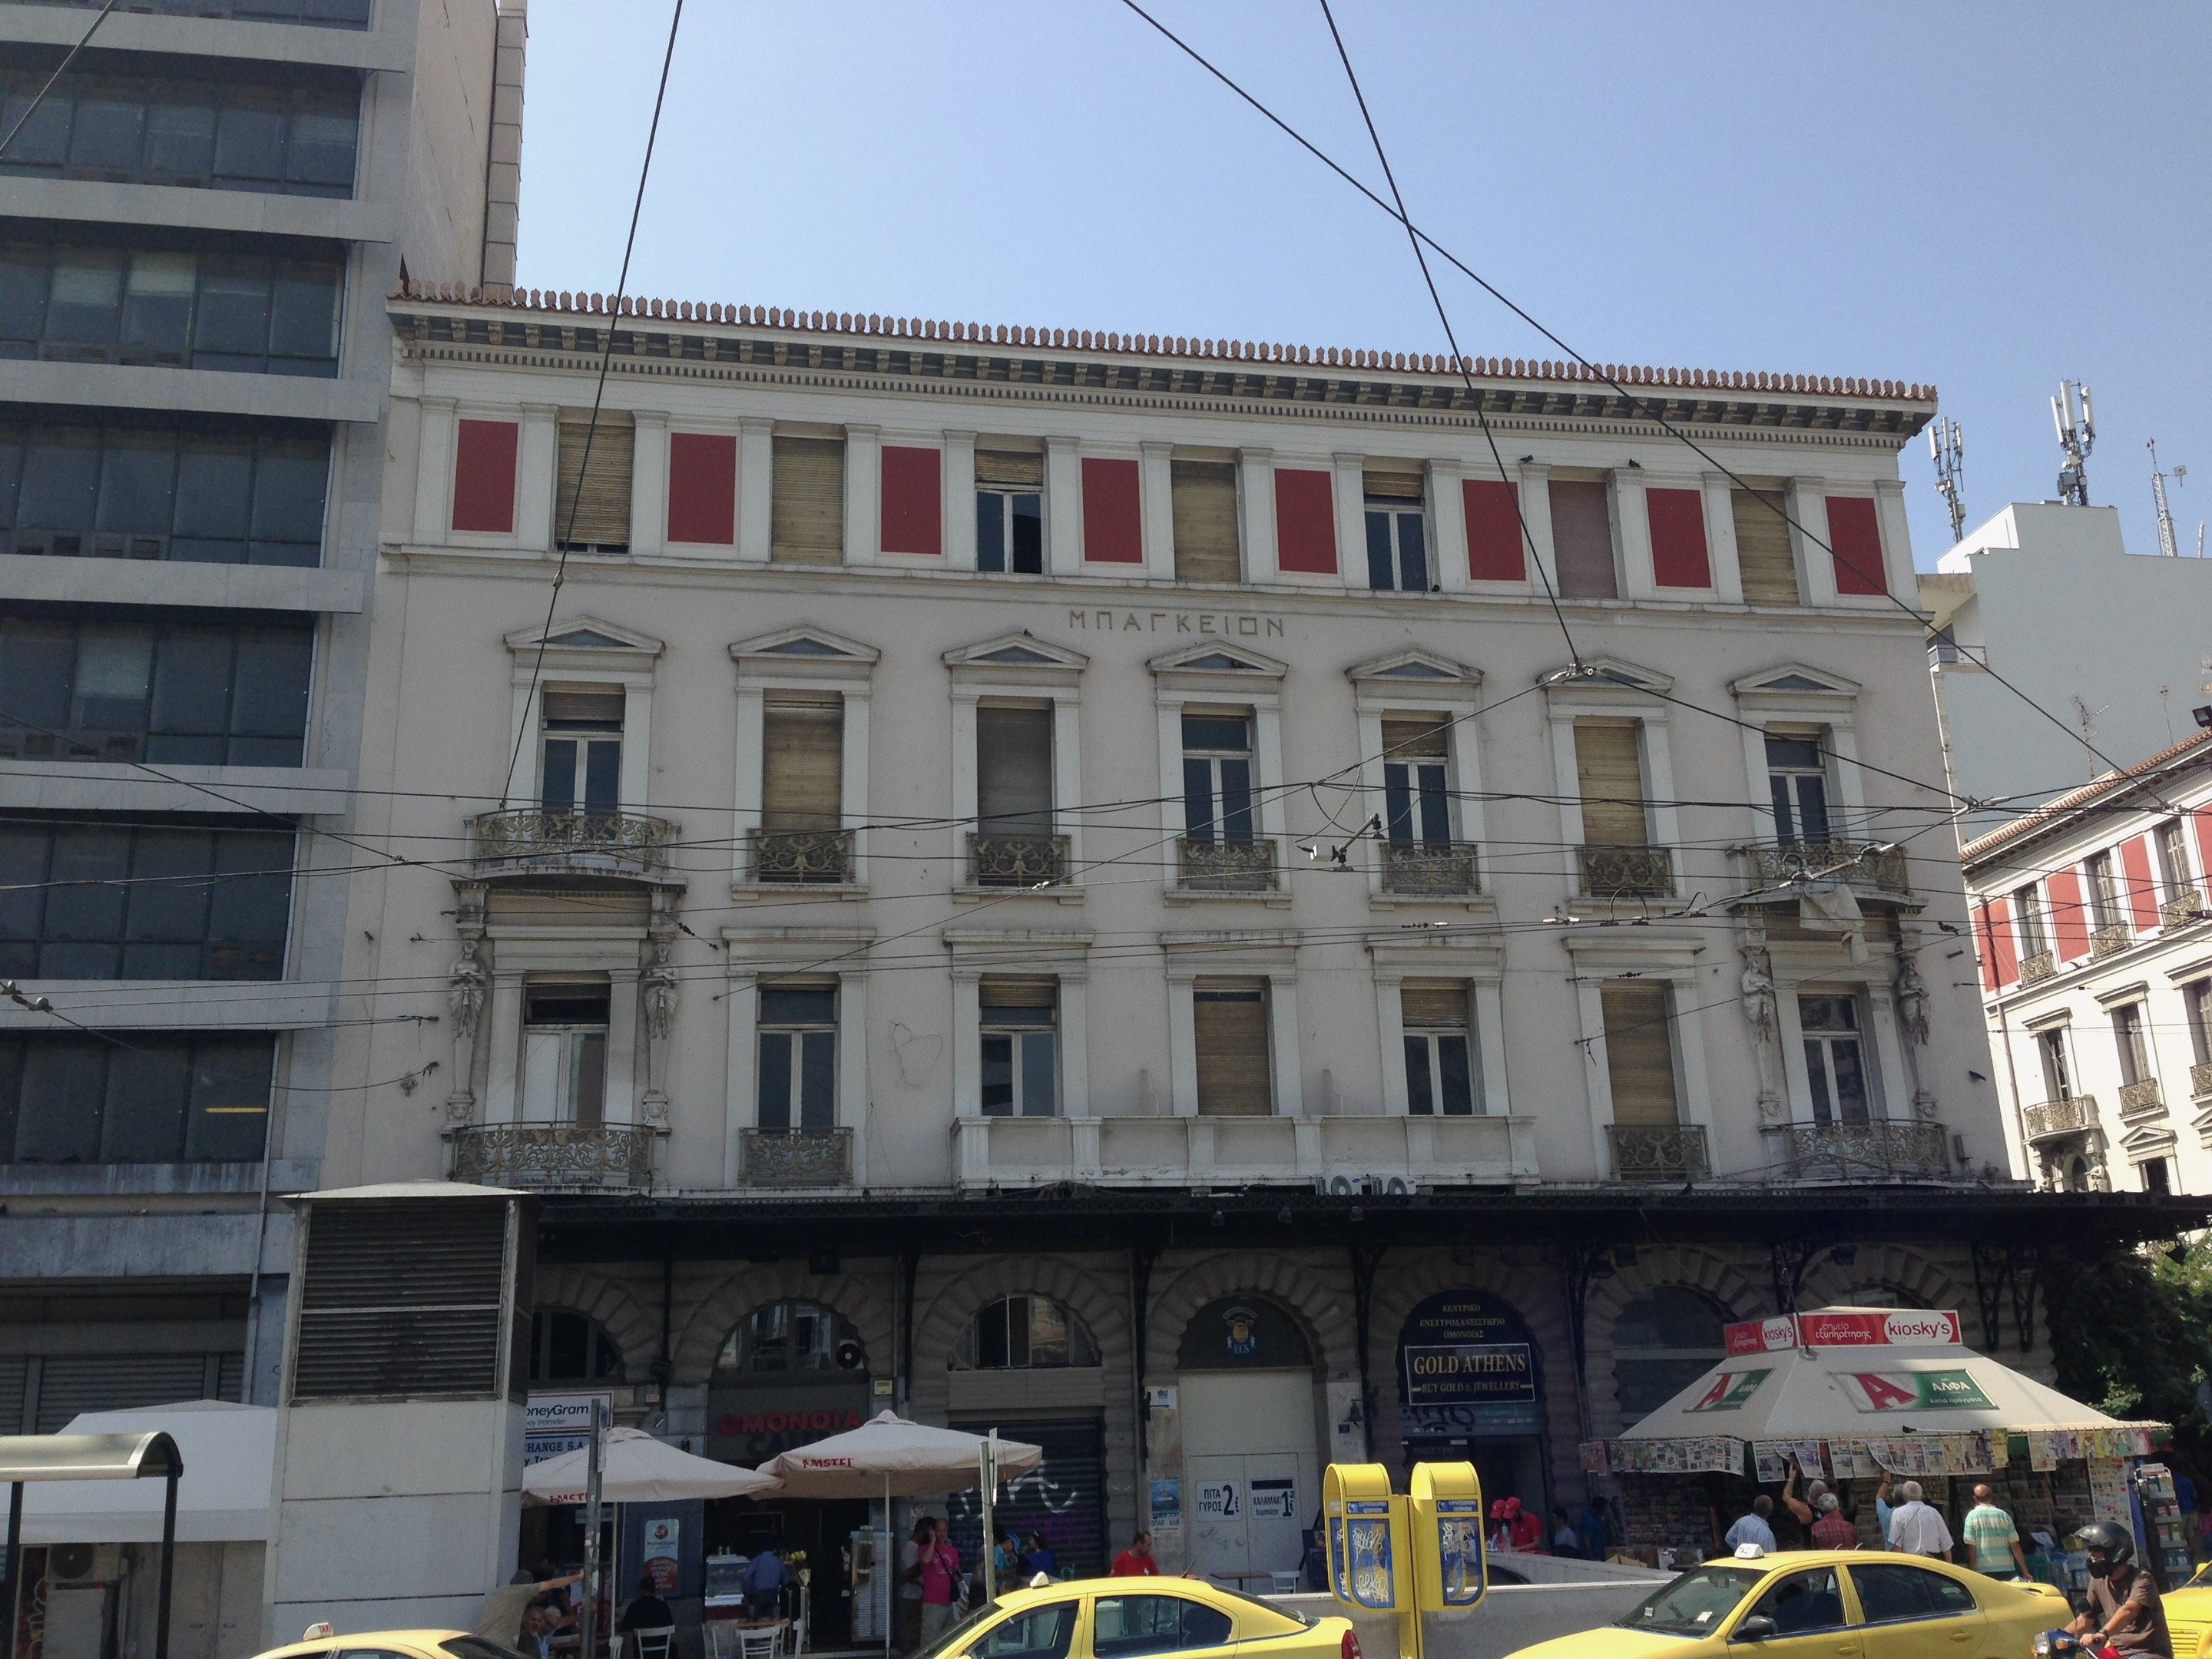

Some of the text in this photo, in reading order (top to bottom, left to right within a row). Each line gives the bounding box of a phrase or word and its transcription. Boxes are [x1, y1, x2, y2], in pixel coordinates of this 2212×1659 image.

[1069, 609, 1284, 637] ΜΠΑΓΚΕΙΟΝ
[1442, 1304, 1481, 1313] ΚΕΝΤΡΙΚΟ
[1443, 1330, 1485, 1339] ΟΜΟΝΟΙΑΣ
[1763, 1326, 1793, 1342] kiosky's
[1888, 1321, 1951, 1339] kiosky's
[1414, 1354, 1525, 1375] GOLD ATHENS
[1422, 1383, 1438, 1393] BUY
[1440, 1382, 1464, 1392] GOLD
[1474, 1382, 1521, 1393] JEWELLERY
[525, 1442, 563, 1452] HANGE
[1204, 1488, 1221, 1499] ΠΙΤΑ
[1199, 1501, 1223, 1512] ΓΥΡΟΣ
